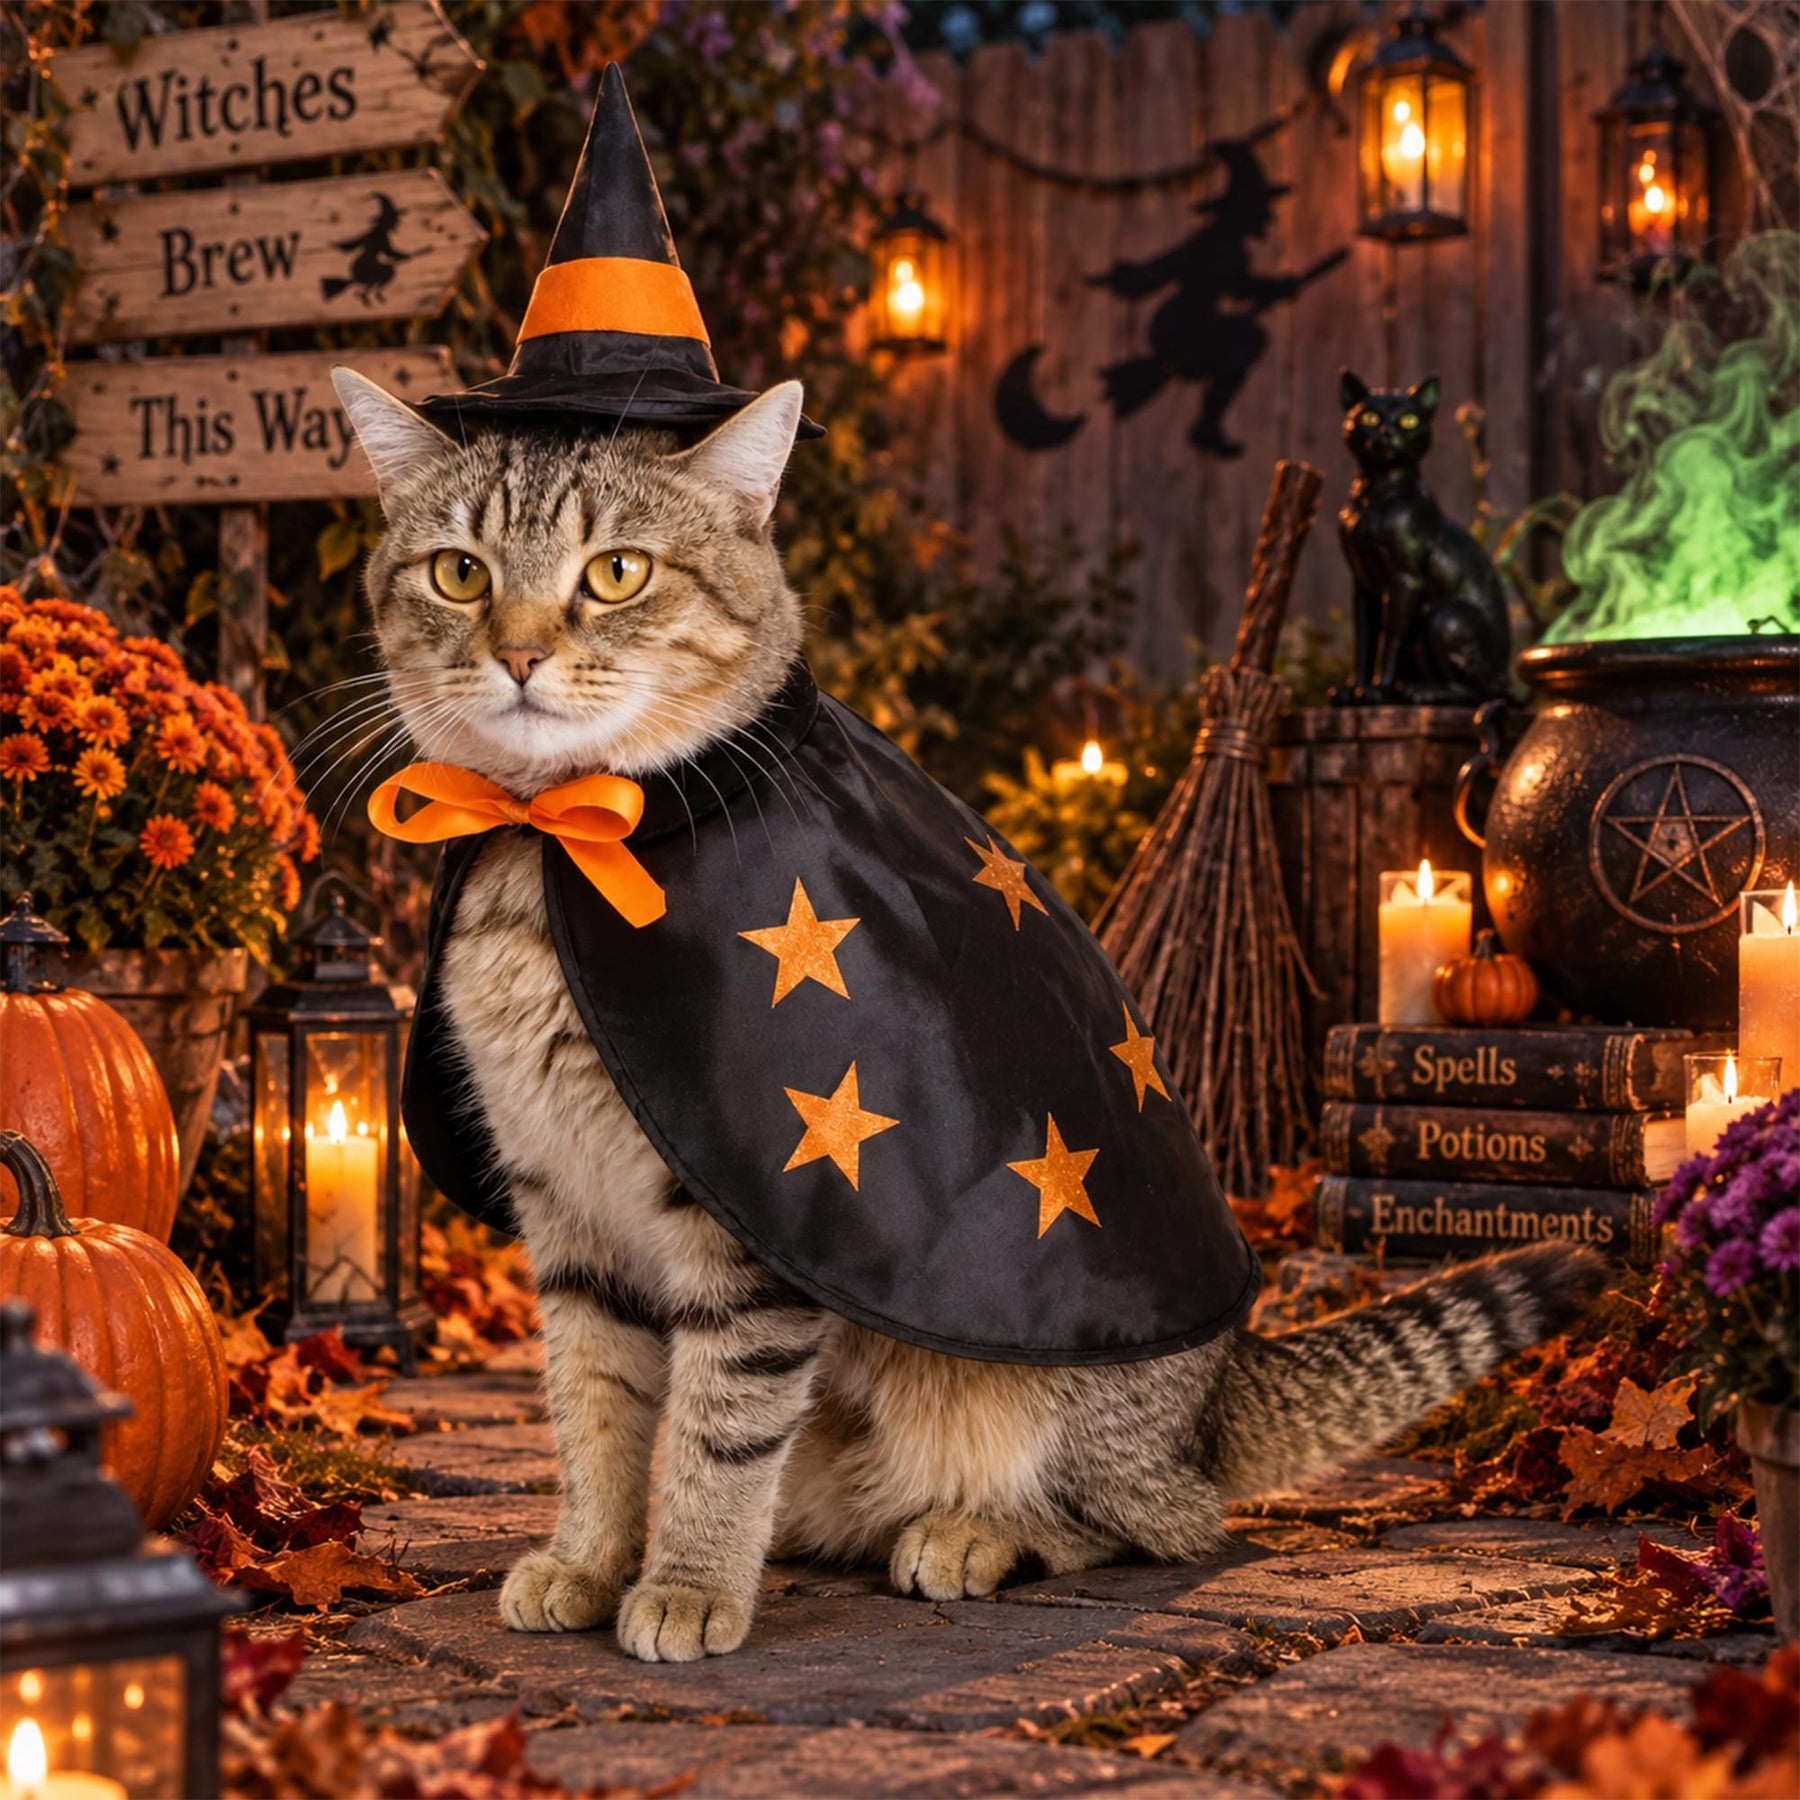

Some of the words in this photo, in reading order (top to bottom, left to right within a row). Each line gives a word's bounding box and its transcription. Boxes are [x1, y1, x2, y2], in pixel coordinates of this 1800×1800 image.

[117, 56, 356, 151] Witches
[159, 226, 302, 298] Brew
[130, 393, 235, 466] This
[251, 386, 356, 470] Way
[1412, 1044, 1518, 1093] Spells
[1416, 1119, 1547, 1163] Potions
[1371, 1193, 1615, 1244] Enchantments
